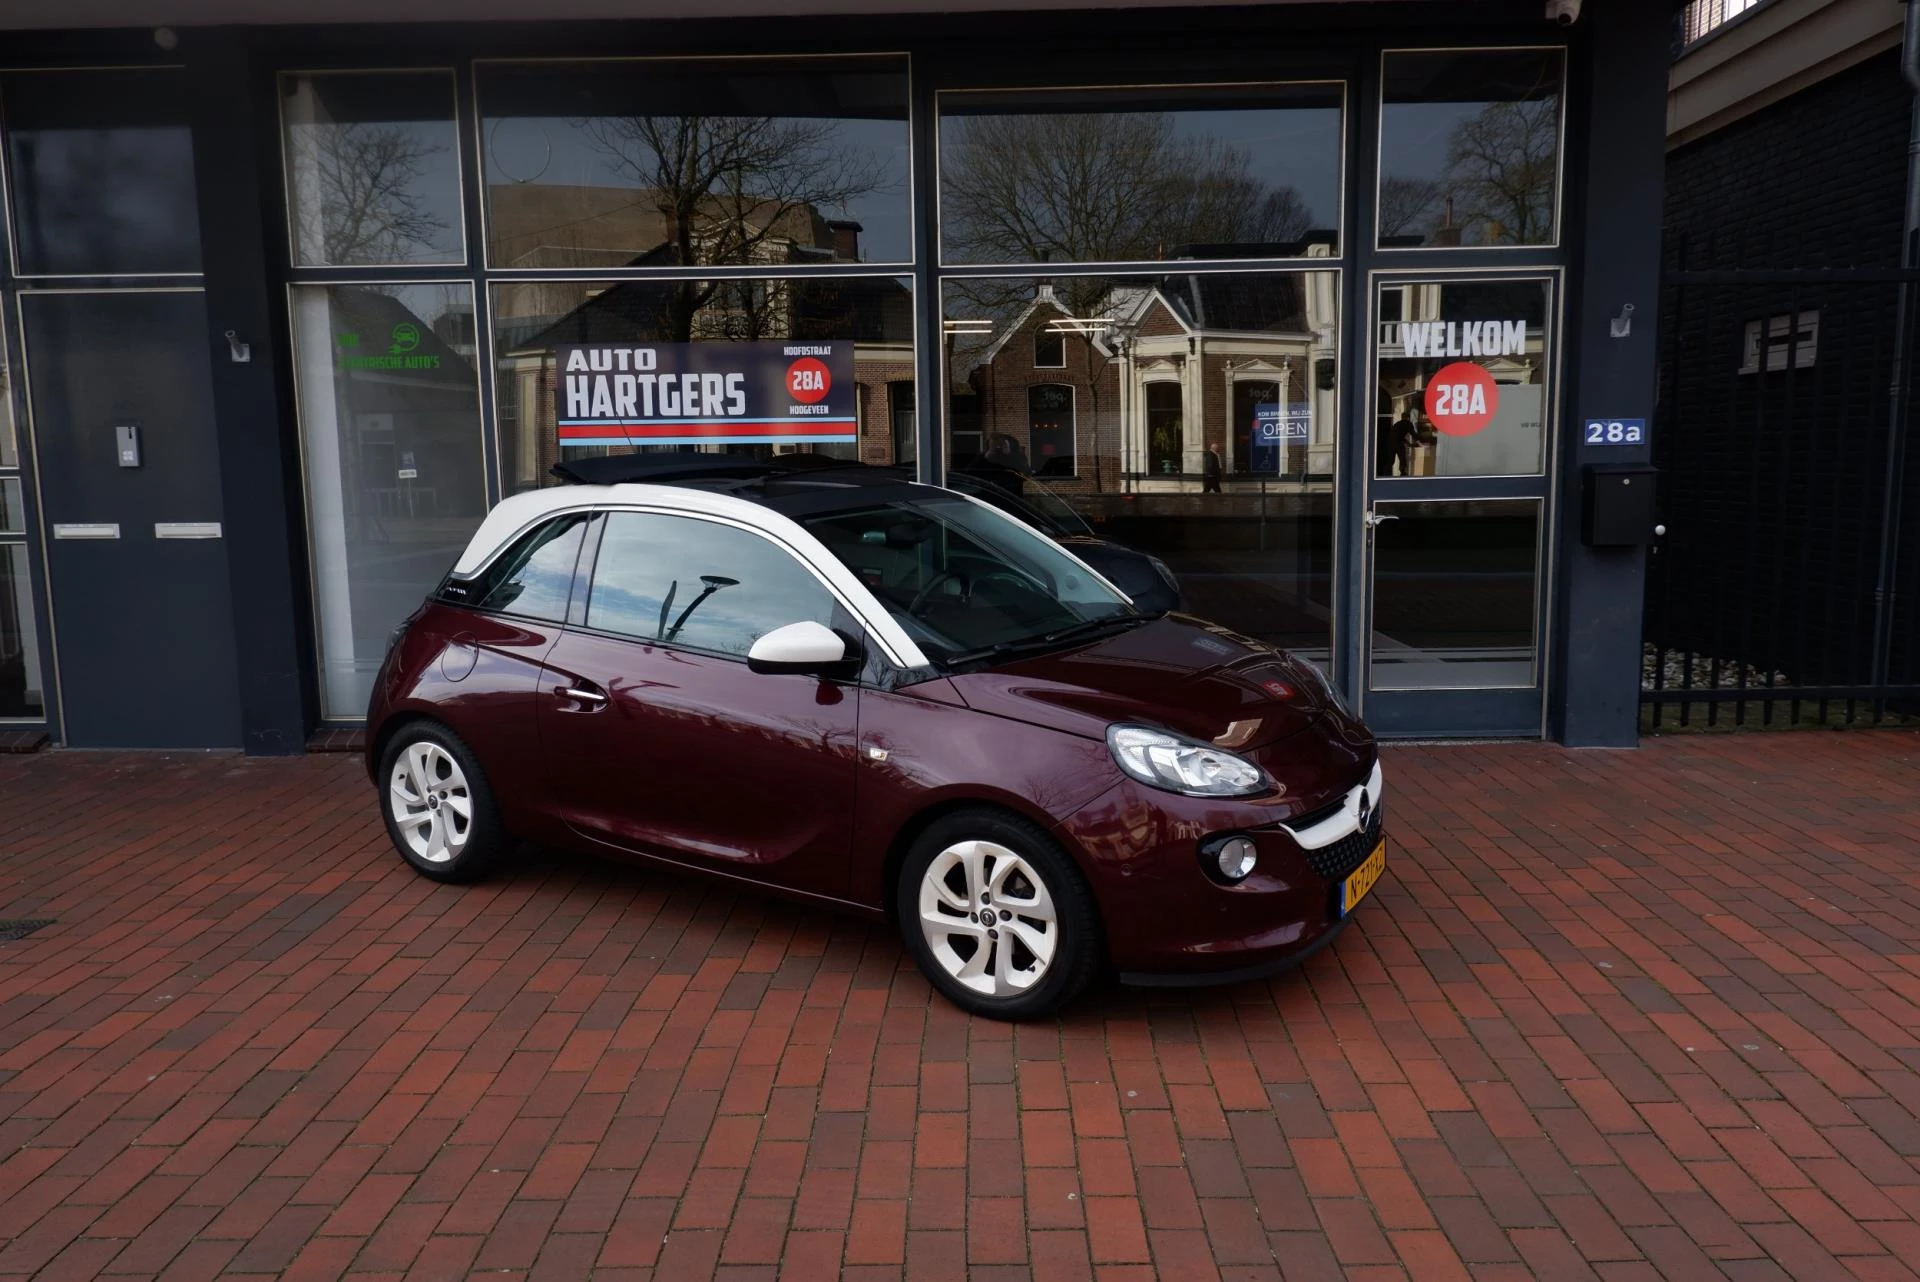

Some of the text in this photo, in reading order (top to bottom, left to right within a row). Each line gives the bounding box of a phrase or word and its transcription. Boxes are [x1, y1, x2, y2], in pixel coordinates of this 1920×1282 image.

[1401, 320, 1526, 357] WELKOM
[566, 349, 657, 371] AUTO
[783, 346, 831, 356] HOOFDSTRAAT
[405, 355, 440, 369] AUTO'S
[793, 371, 824, 390] 28A
[566, 373, 746, 417] HARTGERS
[1435, 384, 1487, 416] 28A
[789, 405, 829, 415] HOOGEVEEN
[1263, 422, 1307, 436] OPEN
[1587, 423, 1641, 443] 28a
